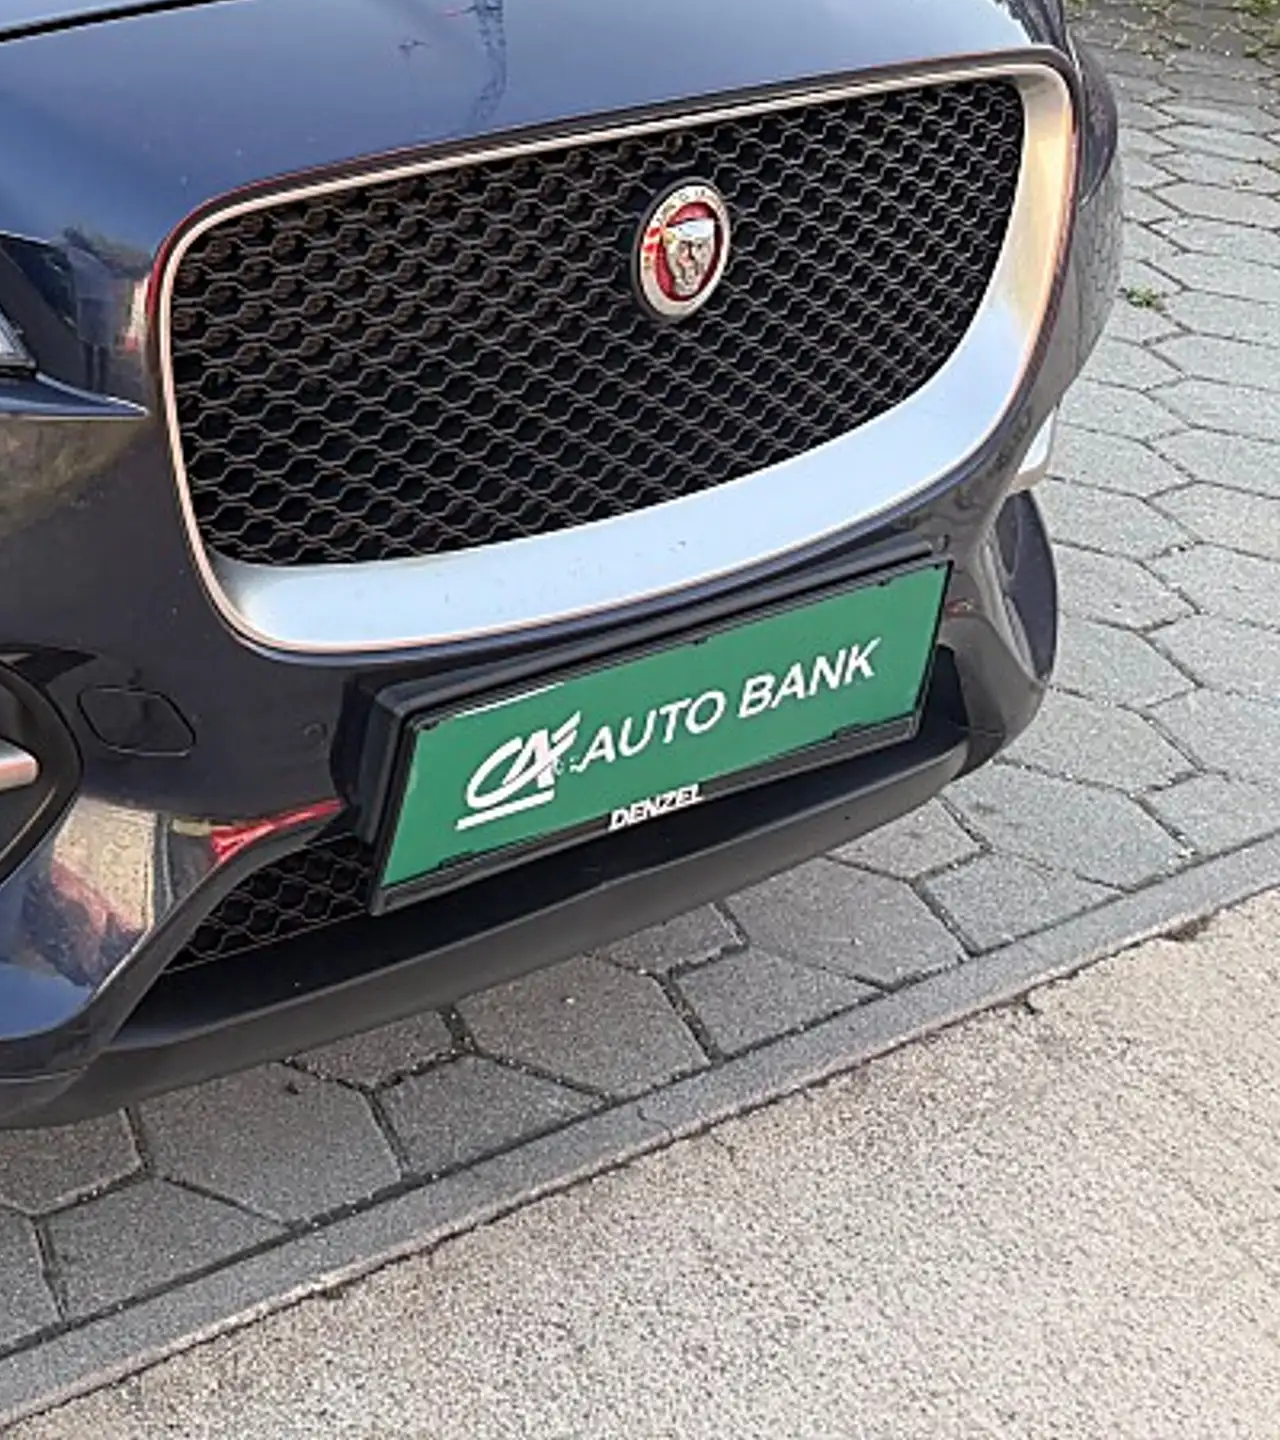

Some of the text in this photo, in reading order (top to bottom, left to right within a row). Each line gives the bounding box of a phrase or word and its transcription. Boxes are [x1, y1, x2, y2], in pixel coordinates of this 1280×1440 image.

[572, 690, 727, 774] AUTO
[737, 636, 882, 719] BANK
[607, 782, 705, 832] DENZEL
